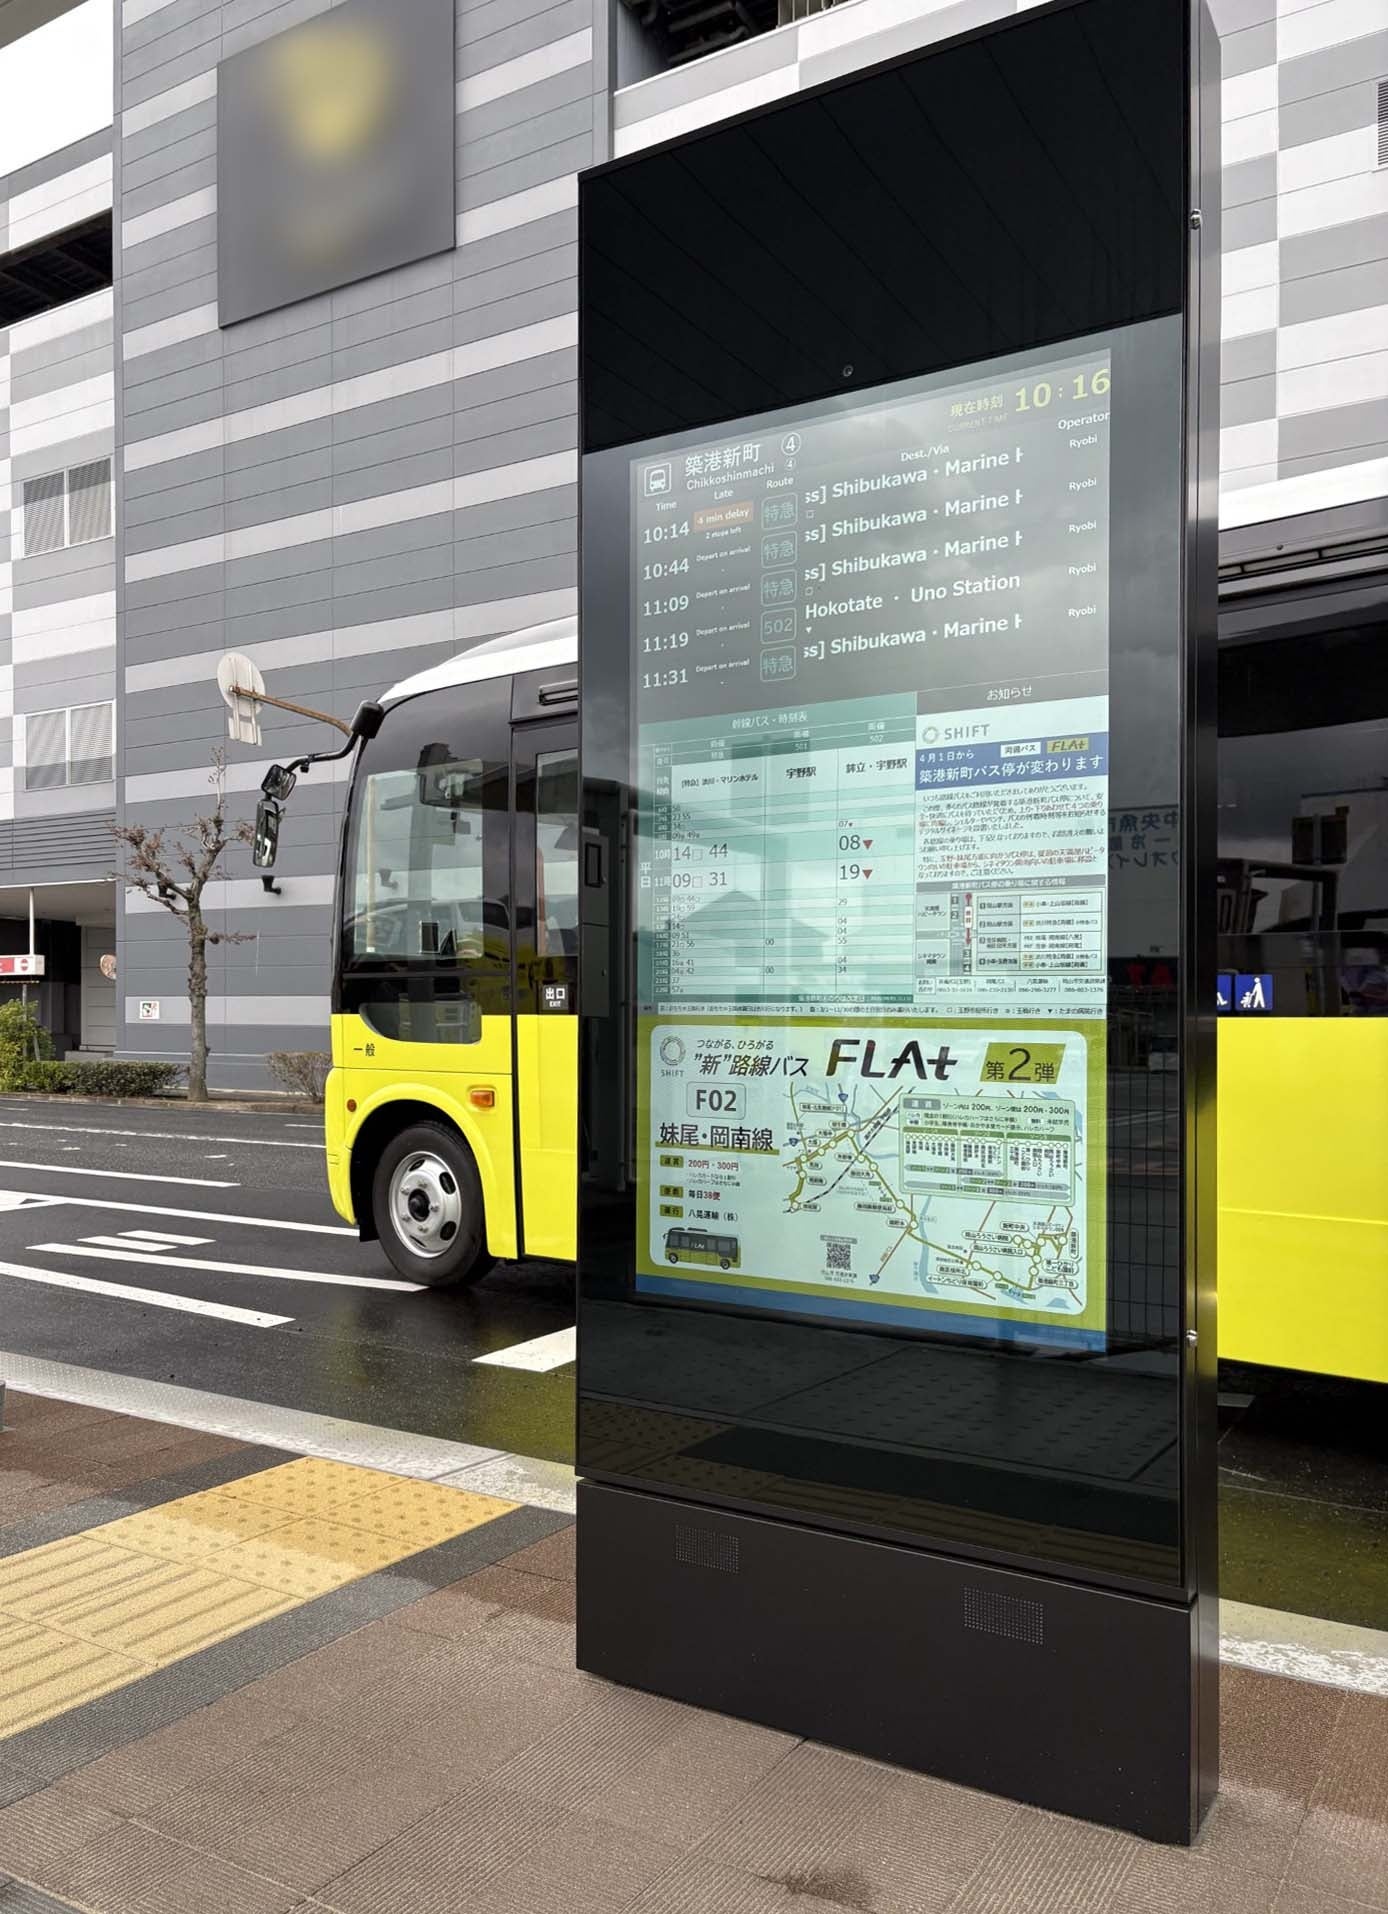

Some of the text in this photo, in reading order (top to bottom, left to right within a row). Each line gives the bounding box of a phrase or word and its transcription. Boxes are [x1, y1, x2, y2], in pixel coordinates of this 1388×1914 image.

[655, 411, 1110, 512] Time Late Route Dest./Via Operator
[684, 443, 761, 477] 築港新町
[643, 521, 690, 544] 10:14
[724, 508, 750, 522] delay
[832, 467, 927, 498] Shibukawa
[946, 452, 1009, 476] Marine
[1069, 434, 1098, 449] Ryobi
[686, 464, 775, 490] Chikkoshinmachi
[643, 558, 690, 580] 10:44
[832, 508, 927, 537] Shibukawa
[945, 492, 1009, 517] Marine
[1069, 477, 1097, 492] Ryobi
[643, 595, 689, 617] 11:09
[831, 547, 927, 577] Shibukawa
[944, 533, 1009, 558] Marine
[1069, 520, 1097, 535] Ryobi
[643, 632, 689, 653] 11:19
[763, 618, 793, 634] 502
[805, 593, 883, 620] Hokotate
[911, 584, 947, 603] Uno
[953, 574, 1021, 597] Station
[1068, 562, 1097, 577] Ryobi
[642, 668, 688, 689] 11:31
[830, 626, 926, 655] Shibukawa
[943, 616, 1008, 639] Marine
[1068, 605, 1097, 619] Ryobi
[987, 684, 1032, 702] お知らせ
[944, 724, 990, 740] SHIFT
[786, 766, 817, 779] 宇野駅
[919, 755, 1103, 784] 築港新町バス停が変わります
[673, 845, 691, 861] 14
[709, 842, 729, 858] 44
[838, 834, 861, 851] 08
[672, 864, 860, 888] 09 31 19
[545, 987, 565, 1000] 出口
[353, 1043, 375, 1057] 一般
[696, 1039, 774, 1050] つながる、ひろがる
[661, 1069, 685, 1078] SHIFT
[985, 1047, 1056, 1082] 第2弾
[696, 1089, 737, 1112] F02
[659, 1122, 774, 1151] 妹尾・岡南線
